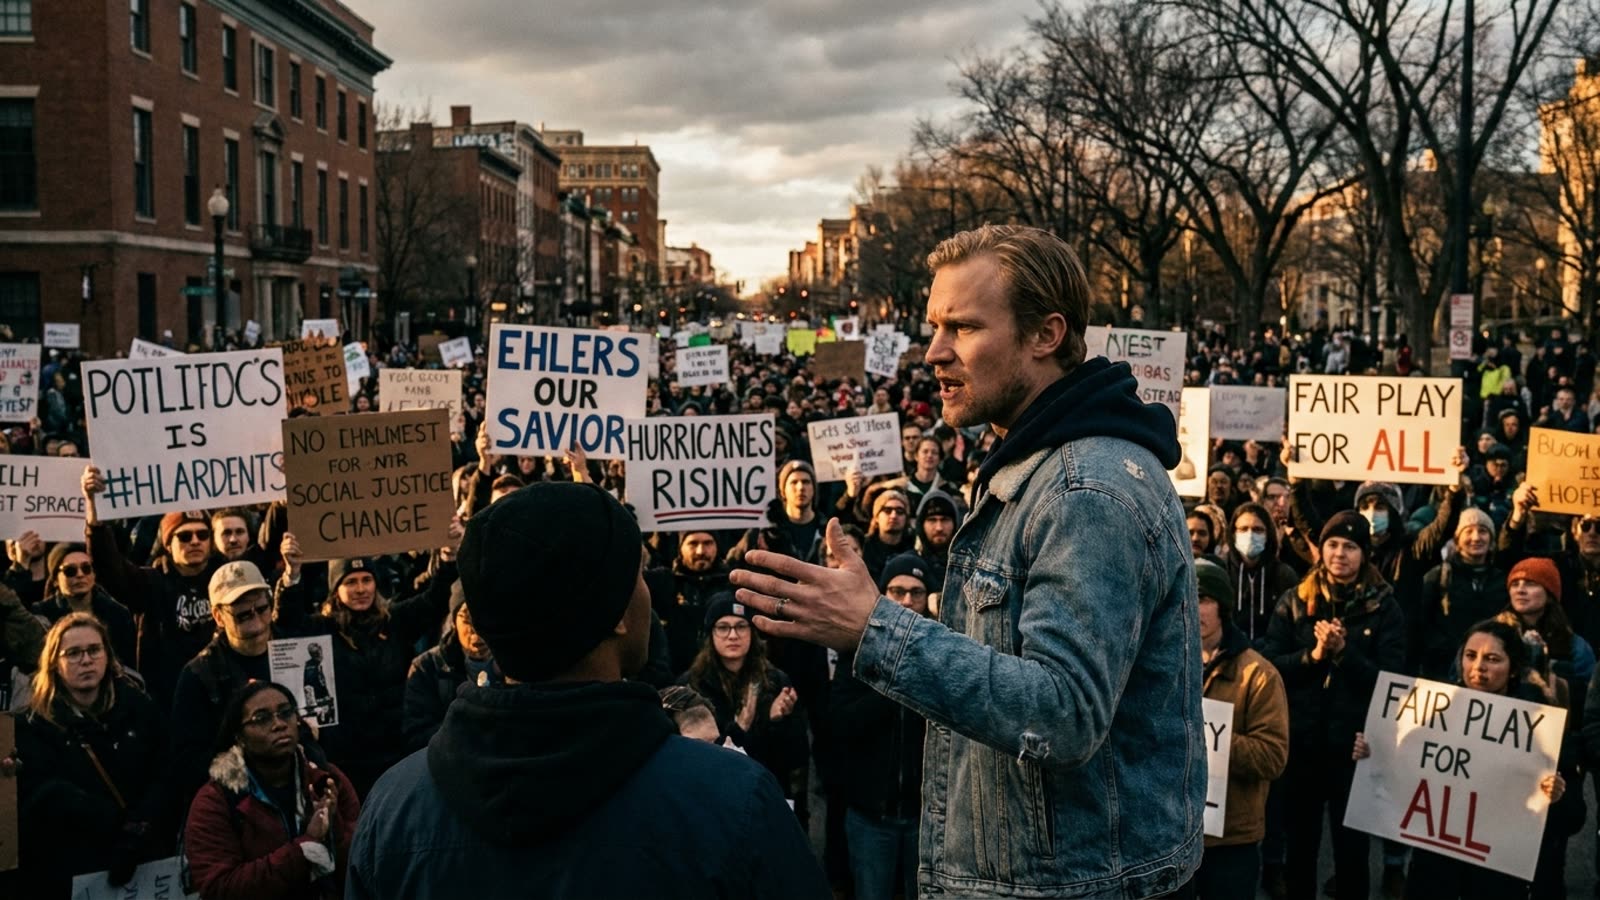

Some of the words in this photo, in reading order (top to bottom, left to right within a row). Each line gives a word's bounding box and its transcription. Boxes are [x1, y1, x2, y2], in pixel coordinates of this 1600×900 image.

[497, 329, 640, 377] EHLERS
[534, 377, 598, 409] OUR
[1295, 382, 1360, 414] FAIR
[1378, 383, 1455, 418] PLAY
[165, 423, 207, 449] IS
[290, 429, 325, 455] NO
[496, 407, 625, 454] SAVIOR
[627, 419, 773, 461] HURRICANES
[329, 459, 360, 474] FOR
[1295, 432, 1350, 464] FOR
[1367, 429, 1445, 474] ALL
[292, 482, 364, 506] SOCIAL
[371, 471, 451, 499] JUSTICE
[652, 465, 766, 510] RISING
[318, 503, 430, 542] CHANGE
[1382, 681, 1450, 732] FAIR
[1463, 698, 1545, 752] PLAY
[1420, 741, 1471, 780] FOR
[1400, 778, 1491, 854] ALL
